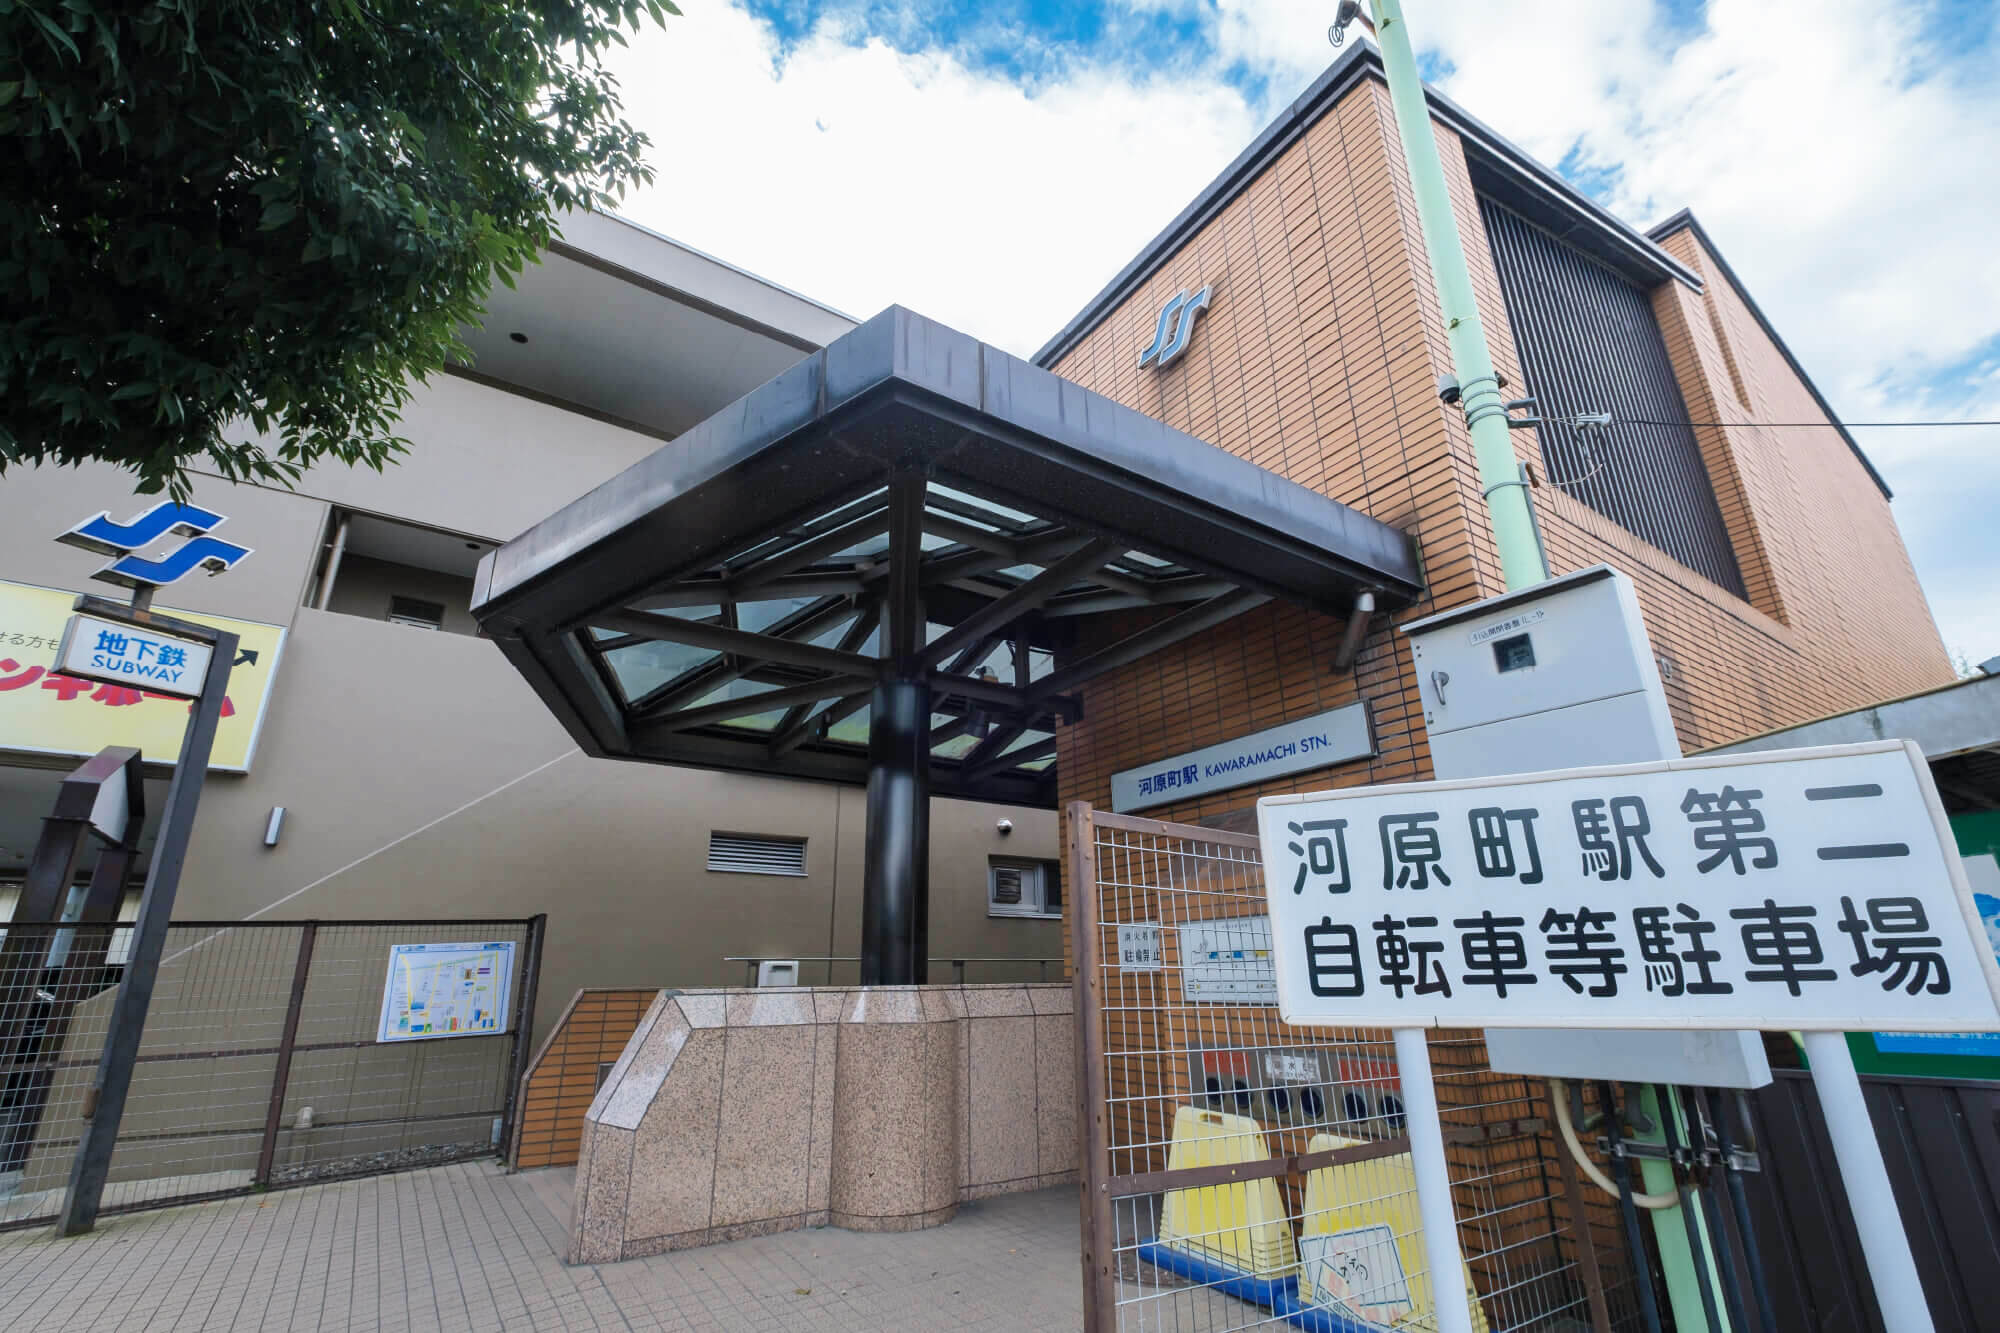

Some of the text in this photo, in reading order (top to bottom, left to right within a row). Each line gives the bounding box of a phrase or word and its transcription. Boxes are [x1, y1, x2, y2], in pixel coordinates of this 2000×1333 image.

[90, 654, 183, 684] SUBWAY
[94, 630, 187, 668] 地下鉄
[1137, 734, 1332, 797] 河原町駅 KAWARAMACHI STN.
[1287, 783, 1911, 895] 河原町駅第二
[1303, 895, 1952, 1000] 自転車等駐車場
